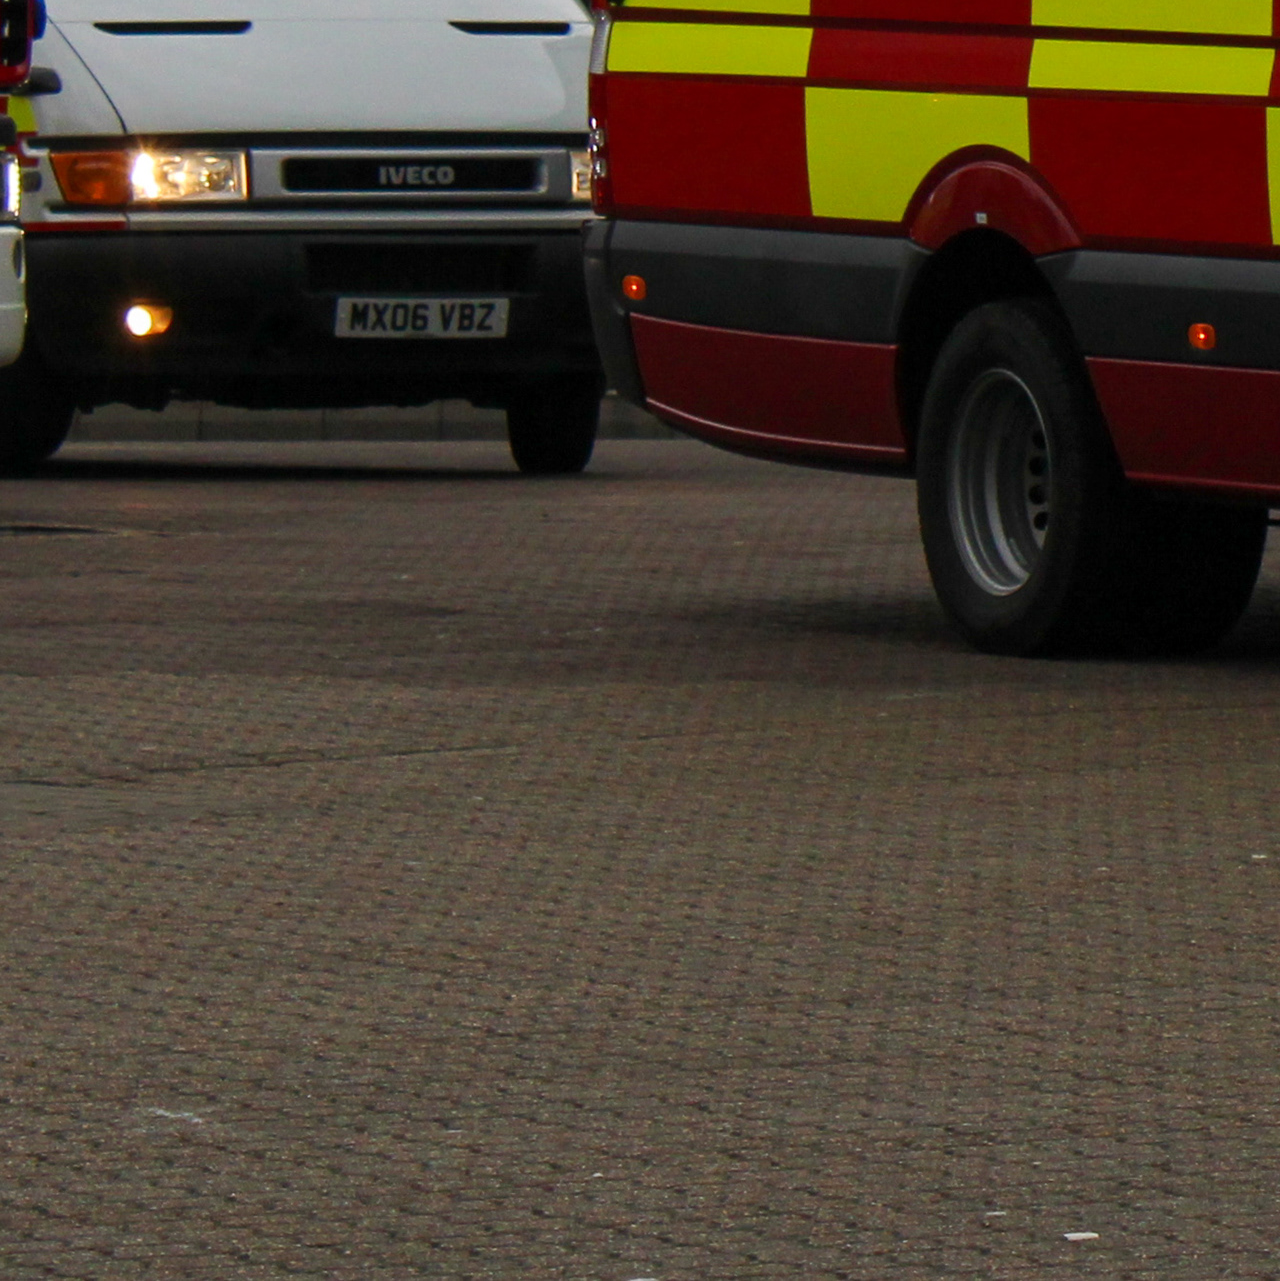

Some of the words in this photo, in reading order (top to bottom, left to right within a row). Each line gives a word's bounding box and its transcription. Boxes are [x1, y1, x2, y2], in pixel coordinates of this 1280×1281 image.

[379, 166, 455, 185] IVECO
[351, 303, 429, 331] MX06
[439, 303, 495, 331] VBZ
